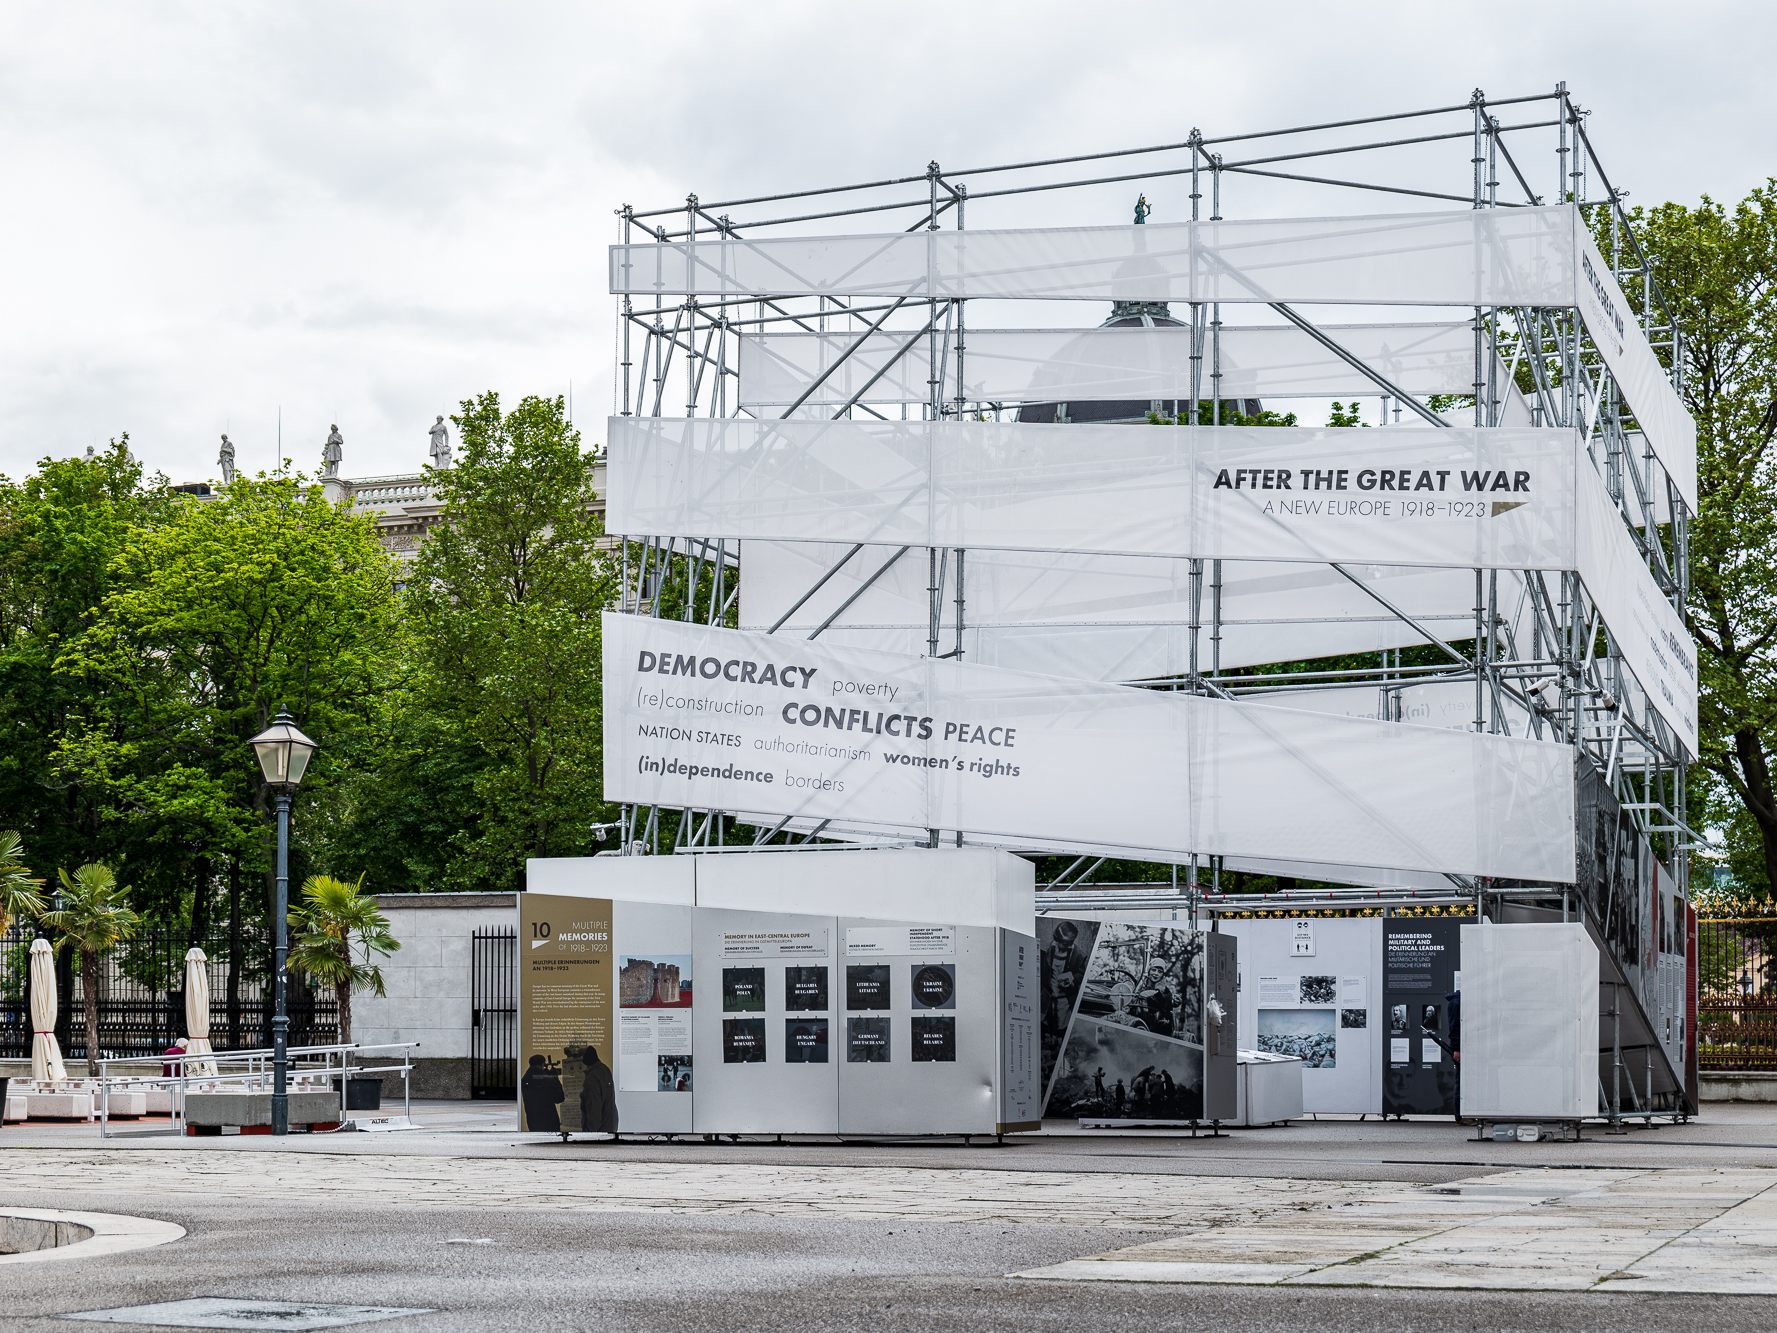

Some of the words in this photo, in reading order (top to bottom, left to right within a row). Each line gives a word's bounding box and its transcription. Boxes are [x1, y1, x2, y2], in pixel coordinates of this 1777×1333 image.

[1213, 468, 1292, 490] AFTER
[1300, 469, 1348, 491] THE
[1357, 469, 1450, 492] GREAT
[1460, 470, 1530, 492] WAR
[1263, 500, 1274, 514] A
[1280, 500, 1322, 515] NEW
[1328, 501, 1391, 516] EUROPE
[638, 650, 818, 690] DEMOCRACY
[832, 680, 899, 702] poverty
[638, 686, 764, 717] (re)construction
[782, 702, 934, 740] CONFLICTS
[944, 722, 1016, 748] PEACE
[638, 724, 692, 742] NATION
[696, 730, 742, 748] STATES
[754, 736, 871, 761] authoritarianism
[970, 757, 1020, 778] rights
[638, 755, 774, 784] (in)dependence
[785, 769, 845, 792] borders
[532, 922, 550, 938] 10
[558, 932, 608, 940] MEMORIES
[572, 921, 608, 930] MULTIPLE
